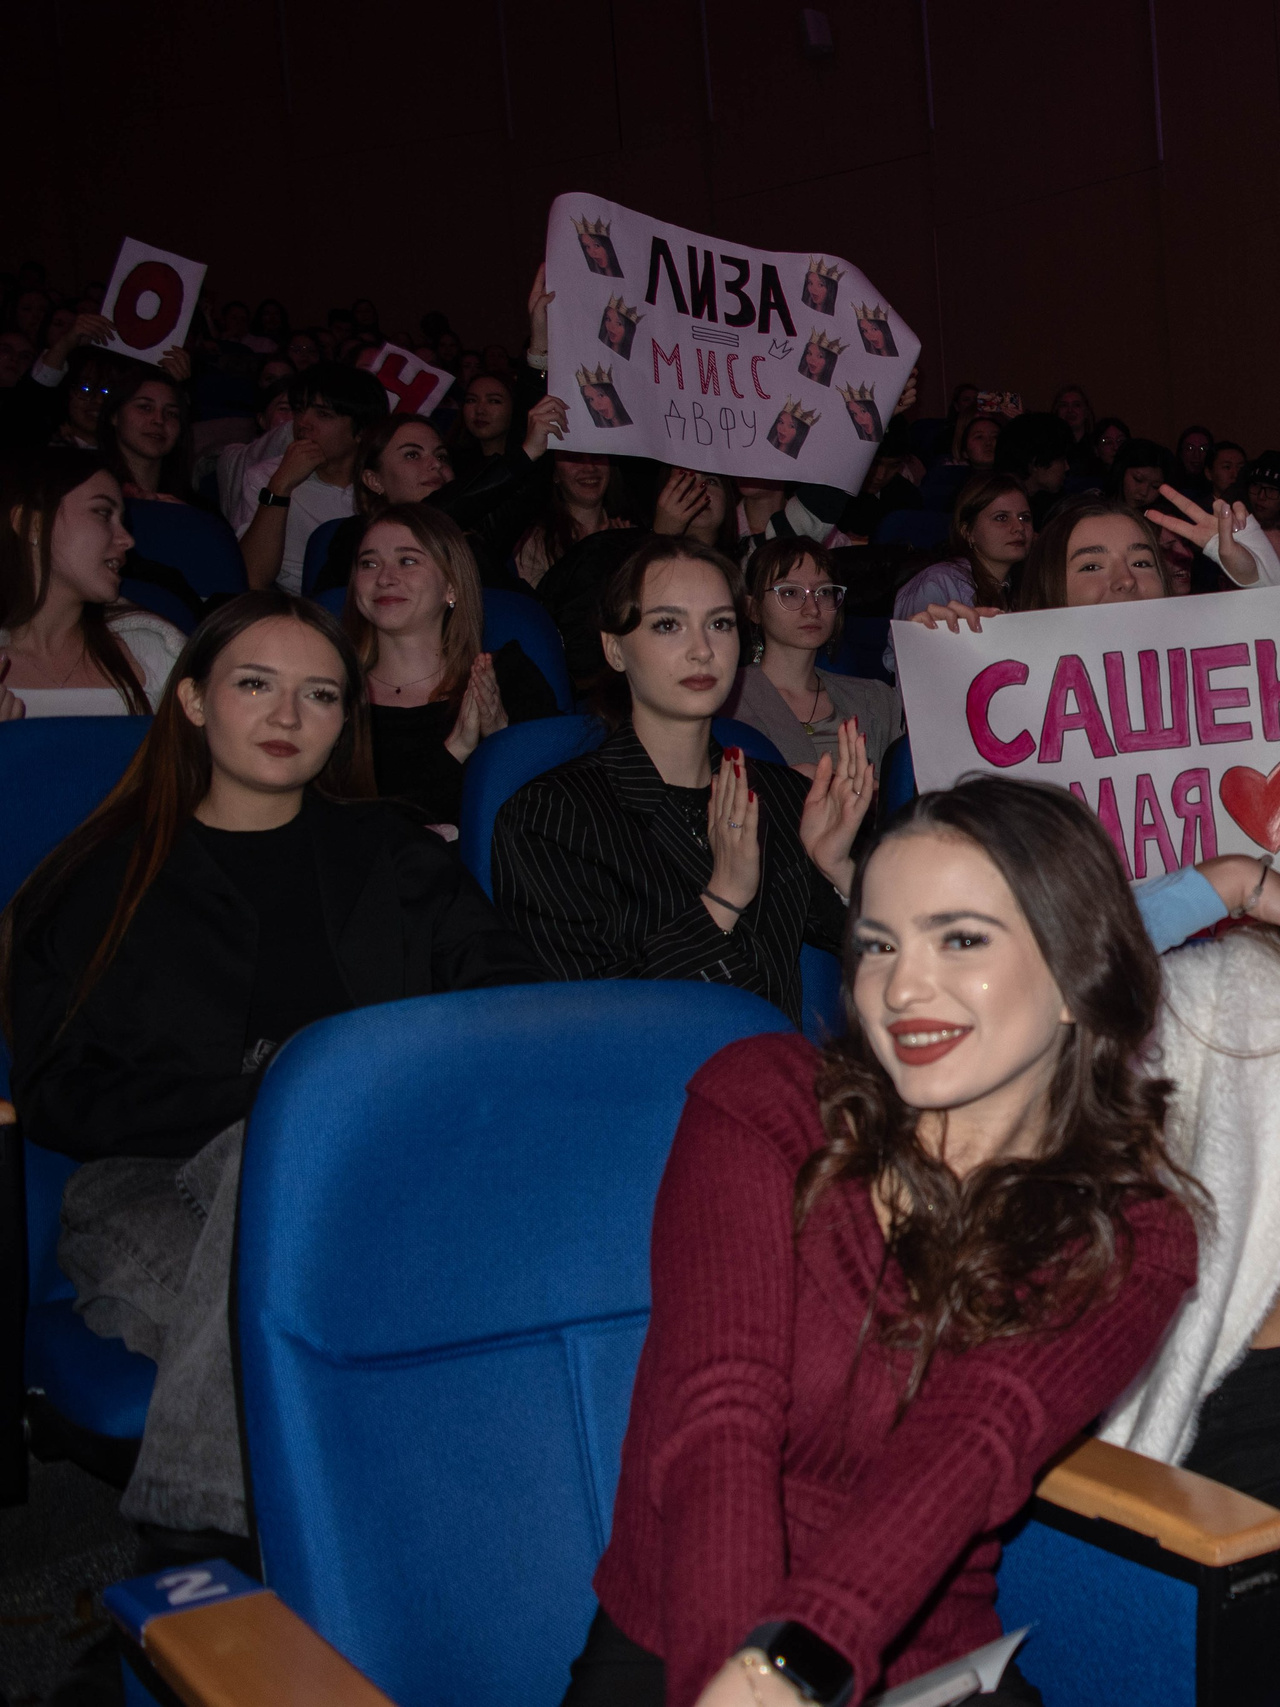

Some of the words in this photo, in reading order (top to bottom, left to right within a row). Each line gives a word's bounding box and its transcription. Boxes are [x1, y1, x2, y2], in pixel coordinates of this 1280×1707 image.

[645, 236, 797, 337] ЛИЗА
[652, 337, 771, 400] МИСС
[664, 399, 756, 449] ДВФУ
